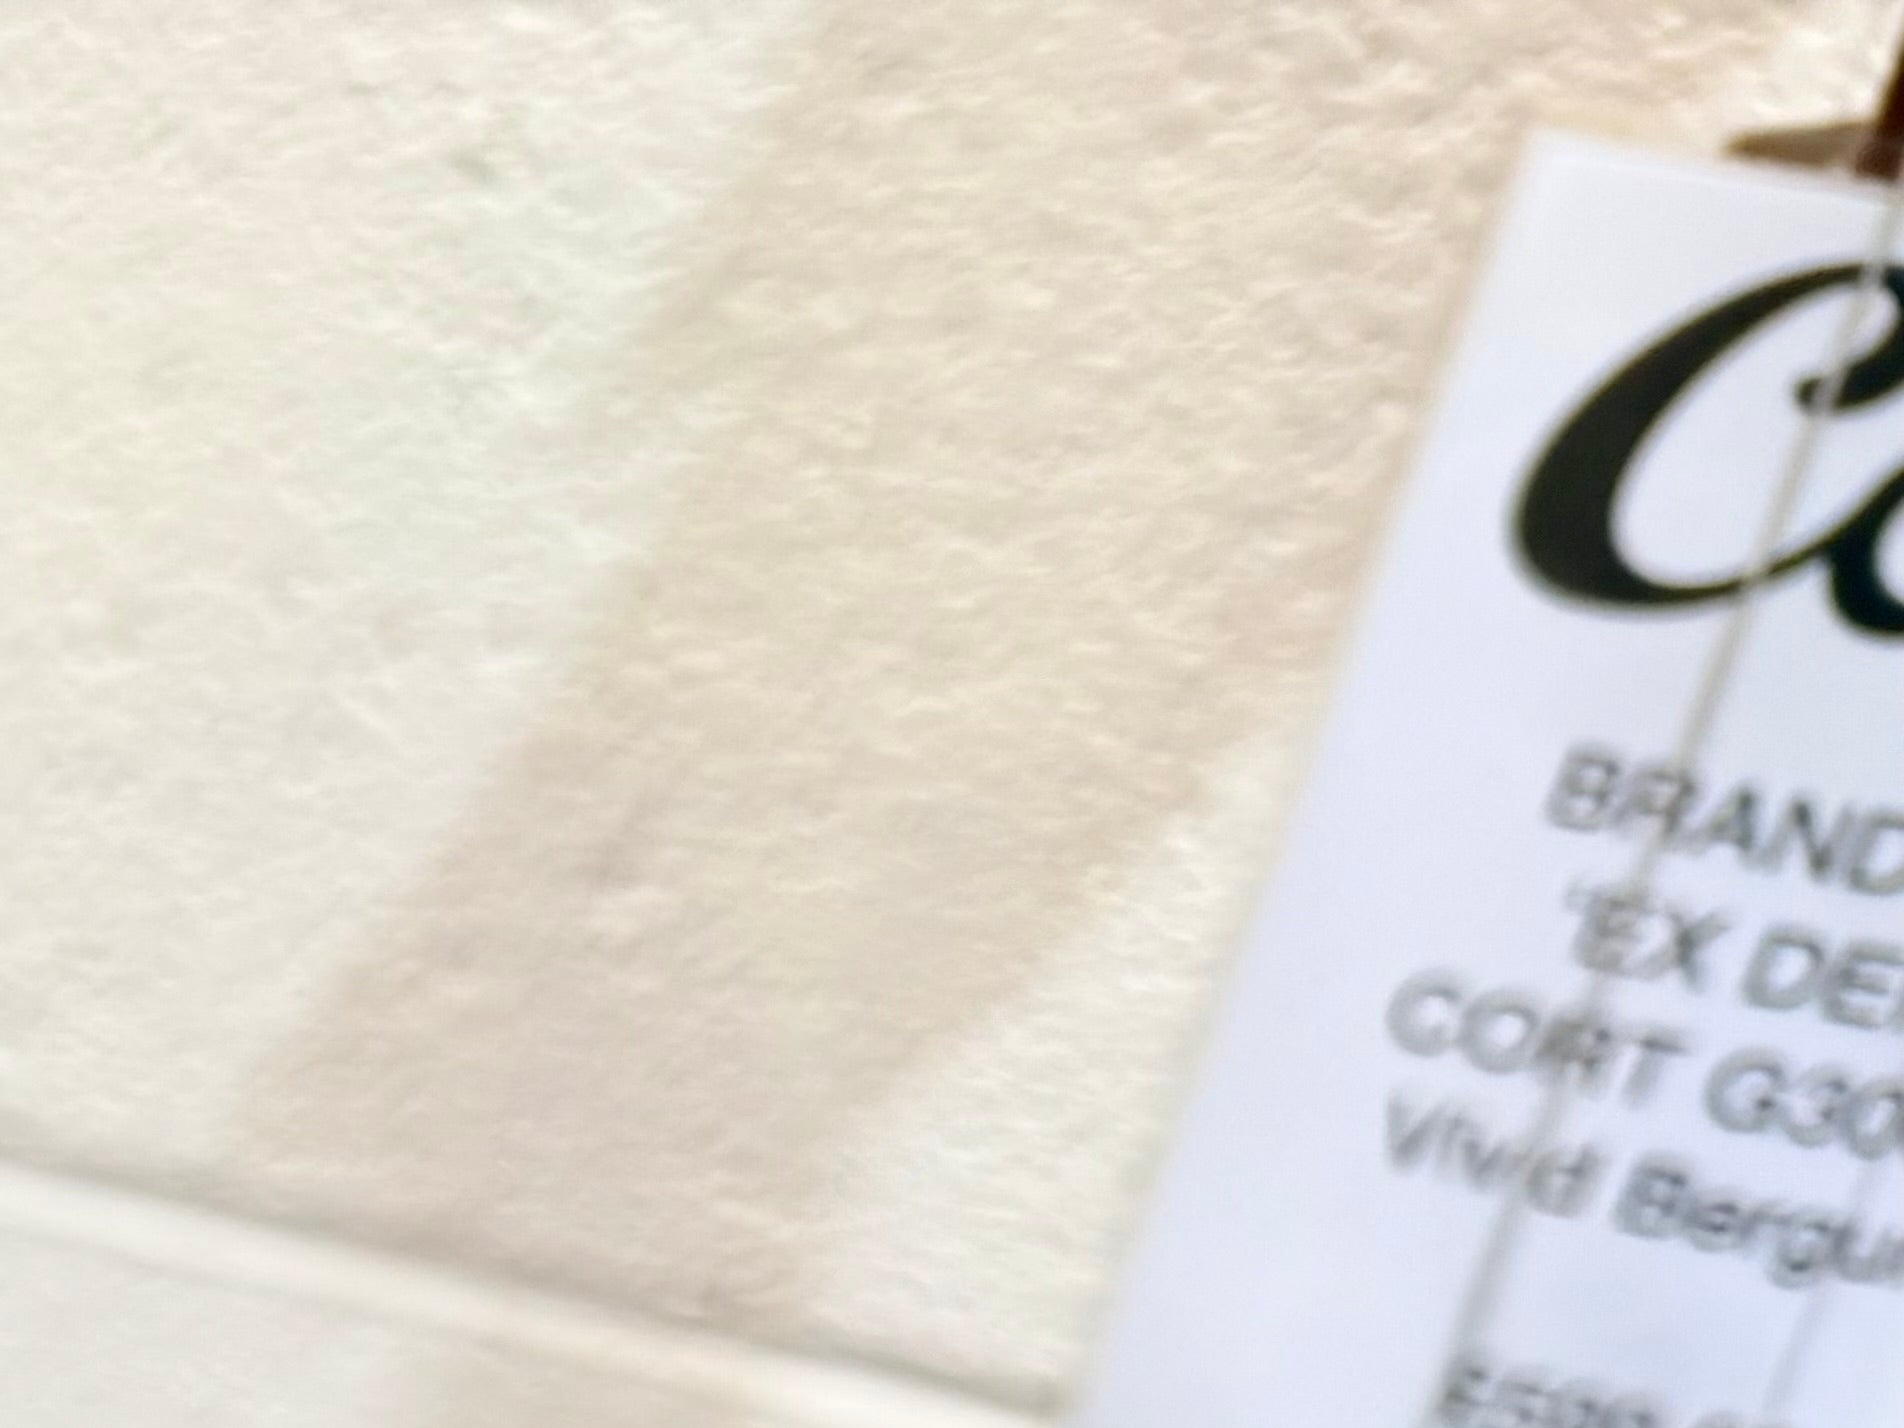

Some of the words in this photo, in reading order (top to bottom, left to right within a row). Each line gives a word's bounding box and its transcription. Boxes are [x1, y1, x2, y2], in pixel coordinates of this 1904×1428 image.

[1550, 746, 1904, 892] BRAND
[1742, 924, 1904, 1031] DE
[1387, 972, 1688, 1106] CORT
[1704, 1049, 1904, 1159] G30
[1386, 1092, 1600, 1214] Vivid
[1614, 1158, 1904, 1288] Bergu
